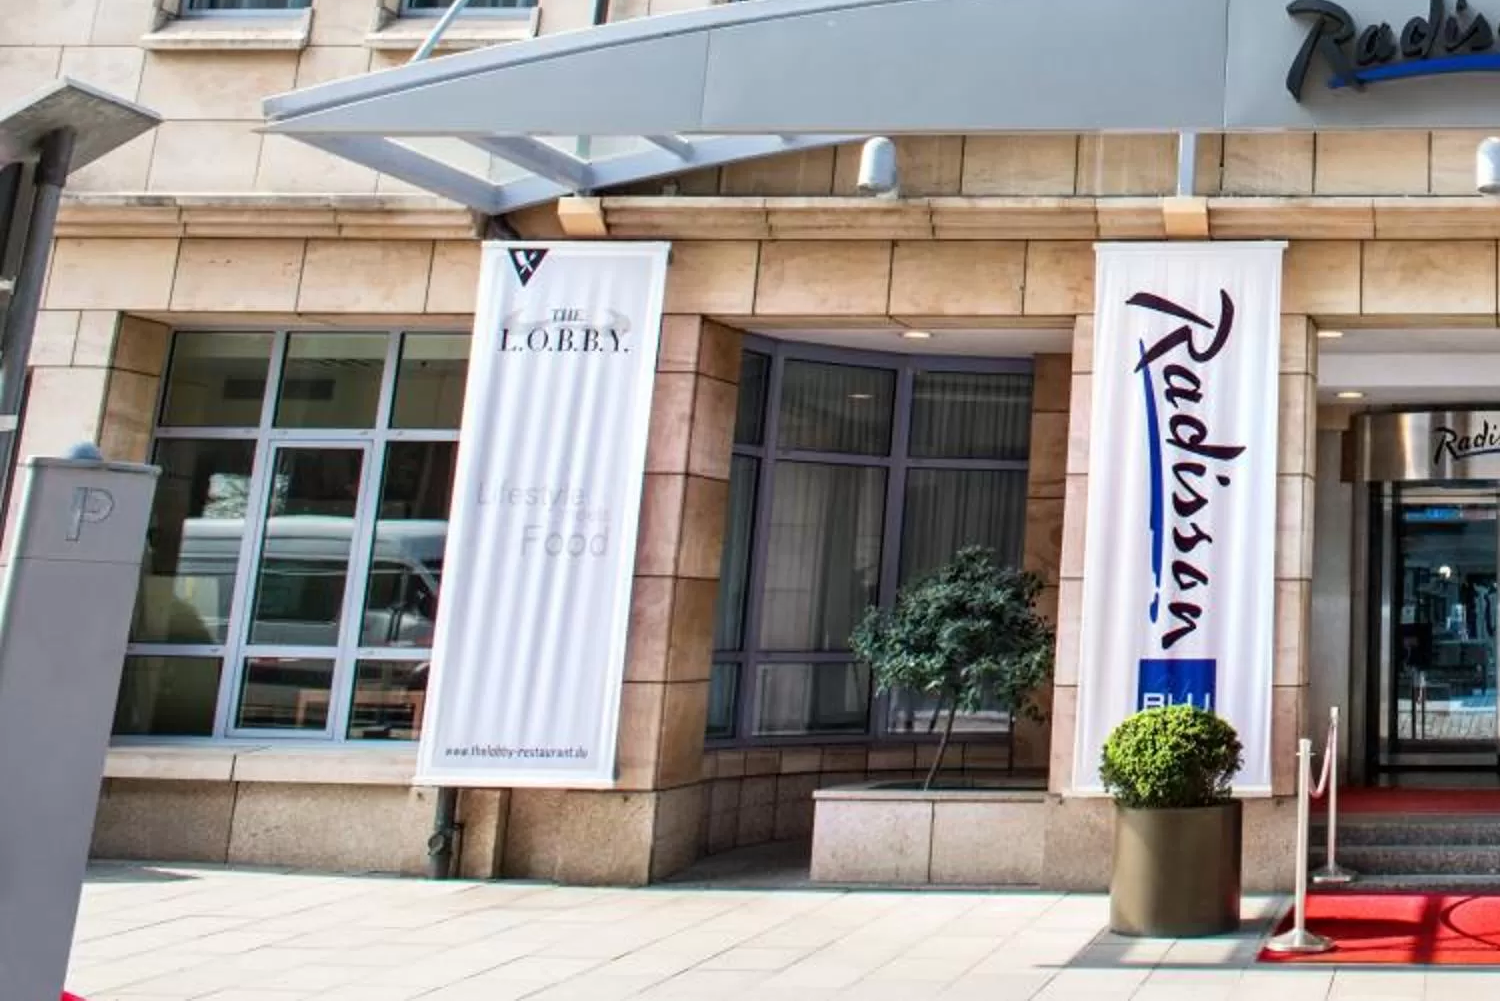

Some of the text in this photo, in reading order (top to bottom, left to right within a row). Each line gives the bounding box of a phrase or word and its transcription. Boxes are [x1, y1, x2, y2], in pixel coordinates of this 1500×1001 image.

[551, 308, 588, 322] THE
[499, 327, 629, 352] L.O.B.B.Y.
[1126, 289, 1247, 649] Radisson
[65, 486, 116, 542] P
[520, 524, 610, 557] Food
